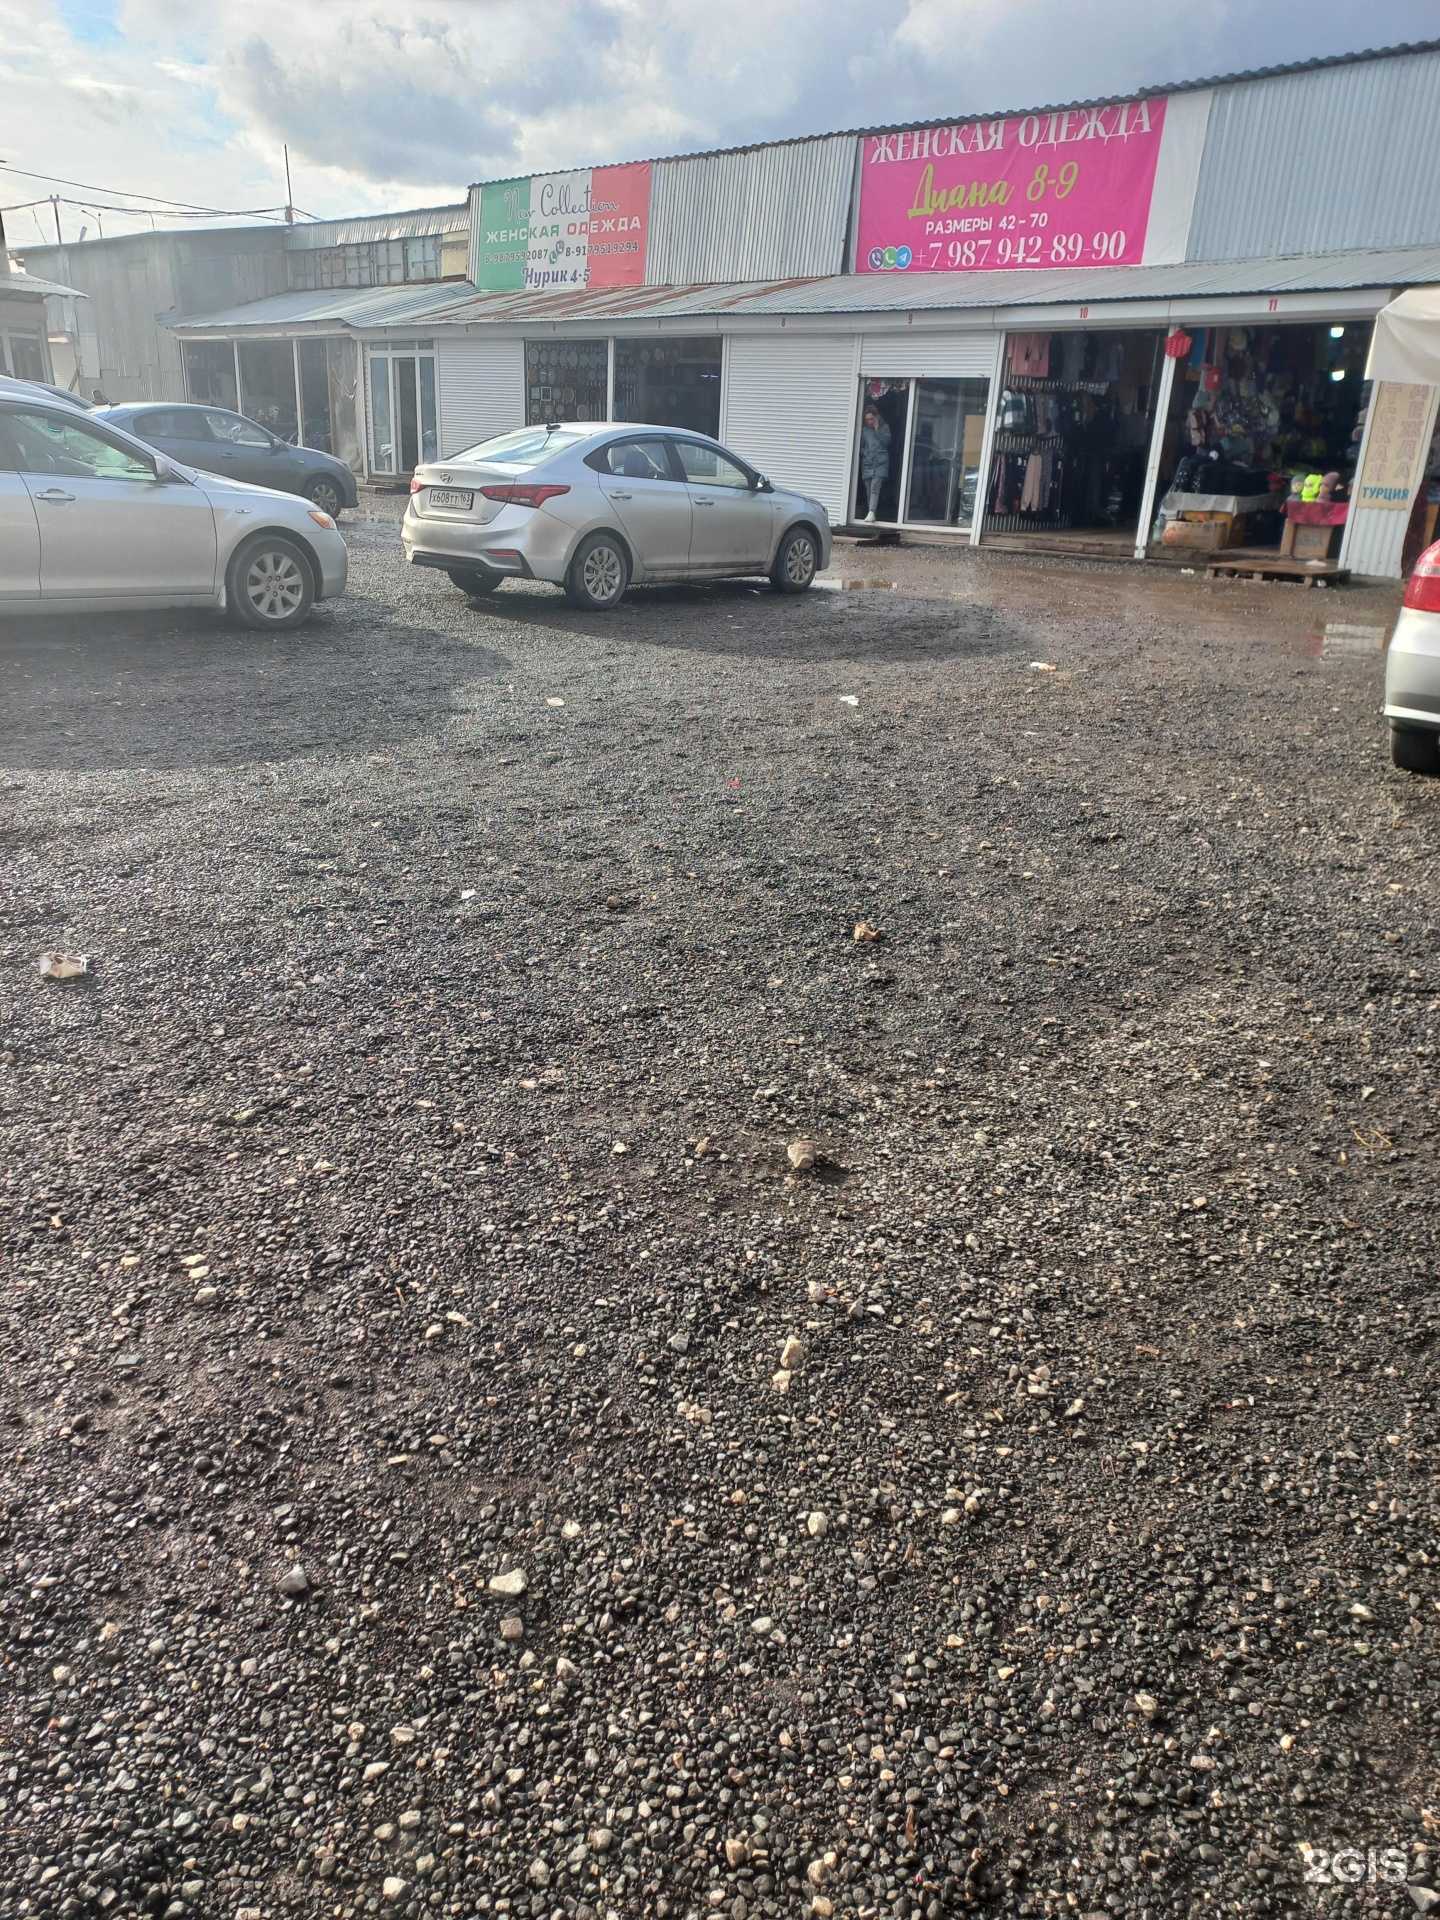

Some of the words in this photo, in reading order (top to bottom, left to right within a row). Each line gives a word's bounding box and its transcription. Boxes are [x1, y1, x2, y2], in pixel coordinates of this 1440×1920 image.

[870, 118, 1007, 164] ЖЕНСКАЯ
[1018, 100, 1152, 152] ОДЕЖДА
[540, 183, 620, 217] Collection
[907, 163, 1016, 220] Диана
[1026, 160, 1079, 202] 8-9
[485, 224, 560, 244] ЖЕНСКАЯ
[567, 216, 641, 236] ОДЕЖДА
[926, 217, 993, 236] РАЗМЕРЫ
[999, 214, 1016, 231] 42
[1030, 212, 1048, 228] 70
[915, 242, 944, 268] +7
[947, 238, 992, 268] 987
[522, 267, 571, 289] Нурик
[1079, 306, 1089, 319] 10
[1362, 486, 1410, 501] ТУРЦИЯ
